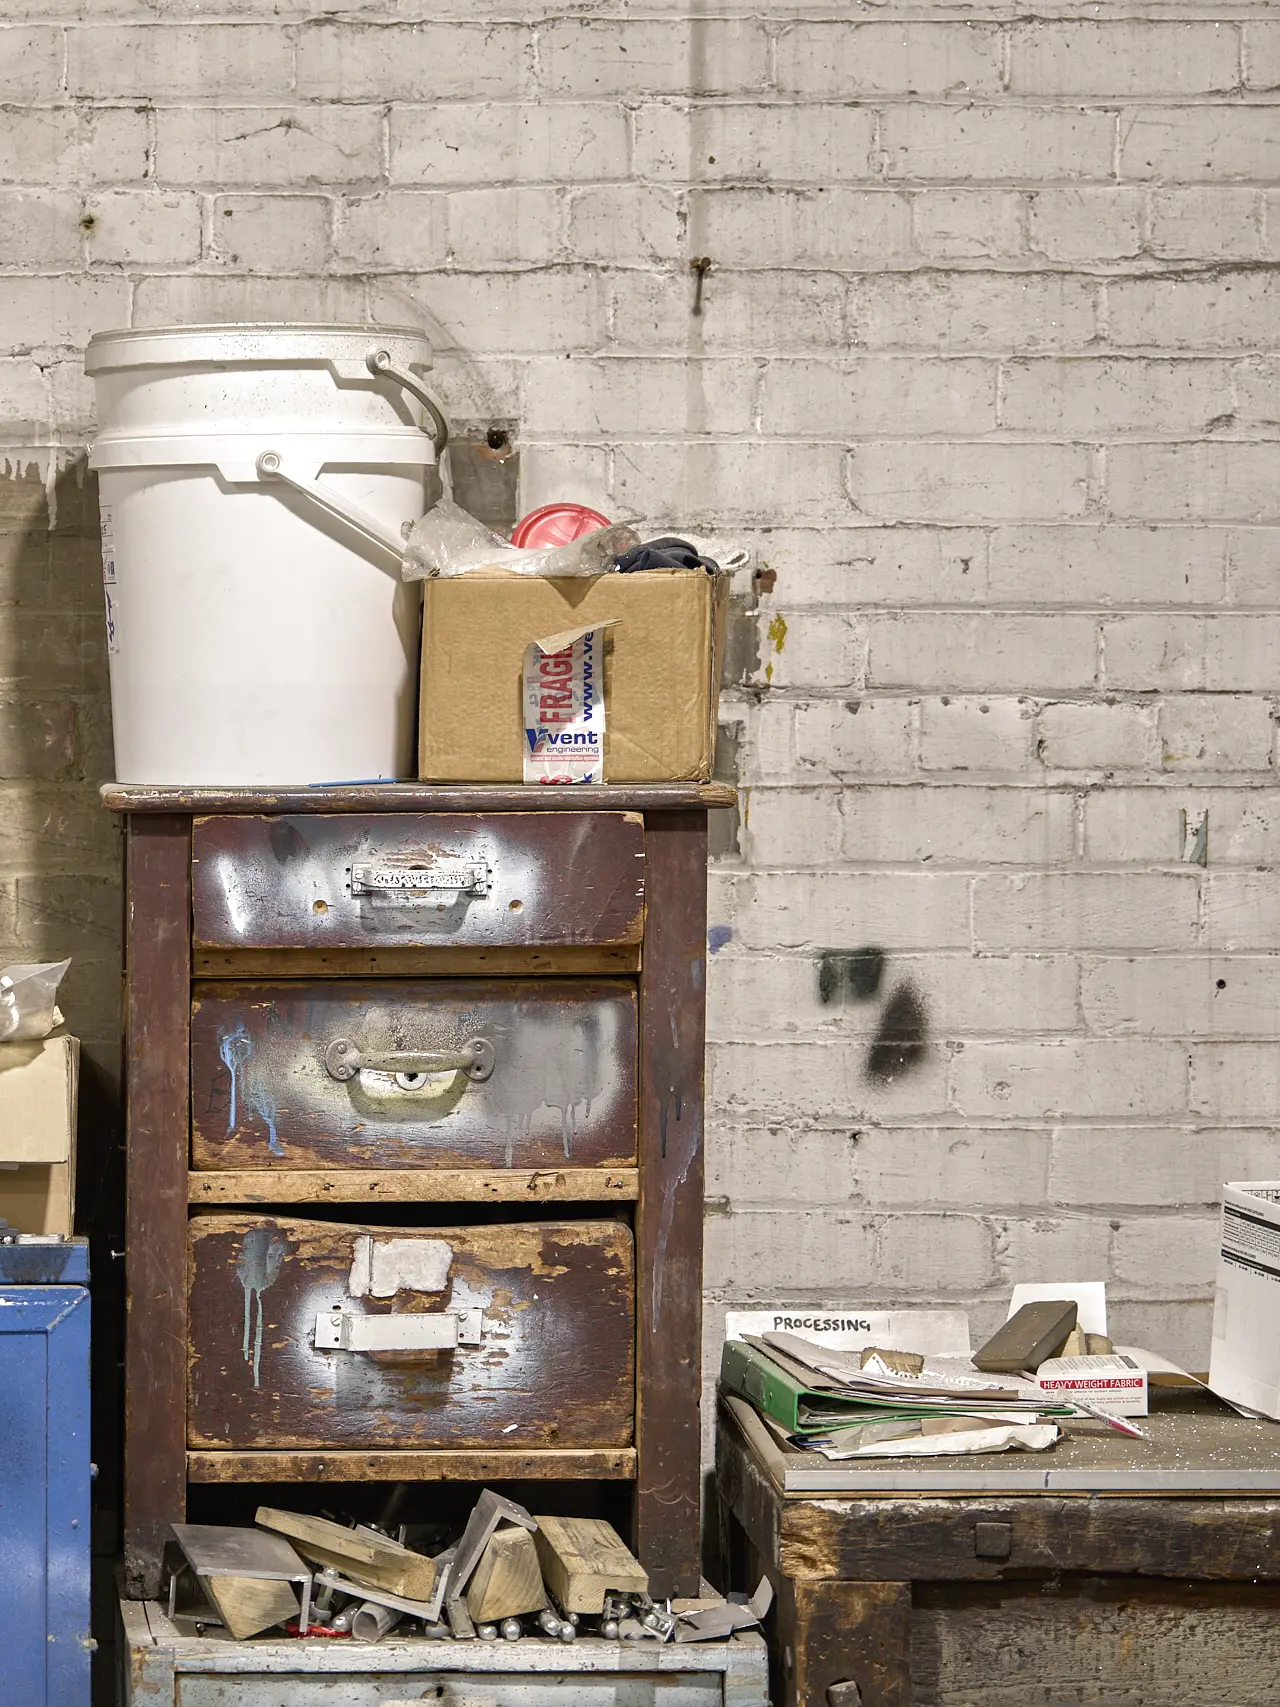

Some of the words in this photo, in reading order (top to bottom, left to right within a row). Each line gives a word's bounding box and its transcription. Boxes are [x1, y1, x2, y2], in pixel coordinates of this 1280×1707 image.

[548, 731, 598, 744] vent
[773, 1316, 871, 1332] PROCESSING
[1043, 1380, 1072, 1389] HEAVY
[1075, 1379, 1109, 1388] WEIGHT
[1110, 1379, 1140, 1387] FABRIC
